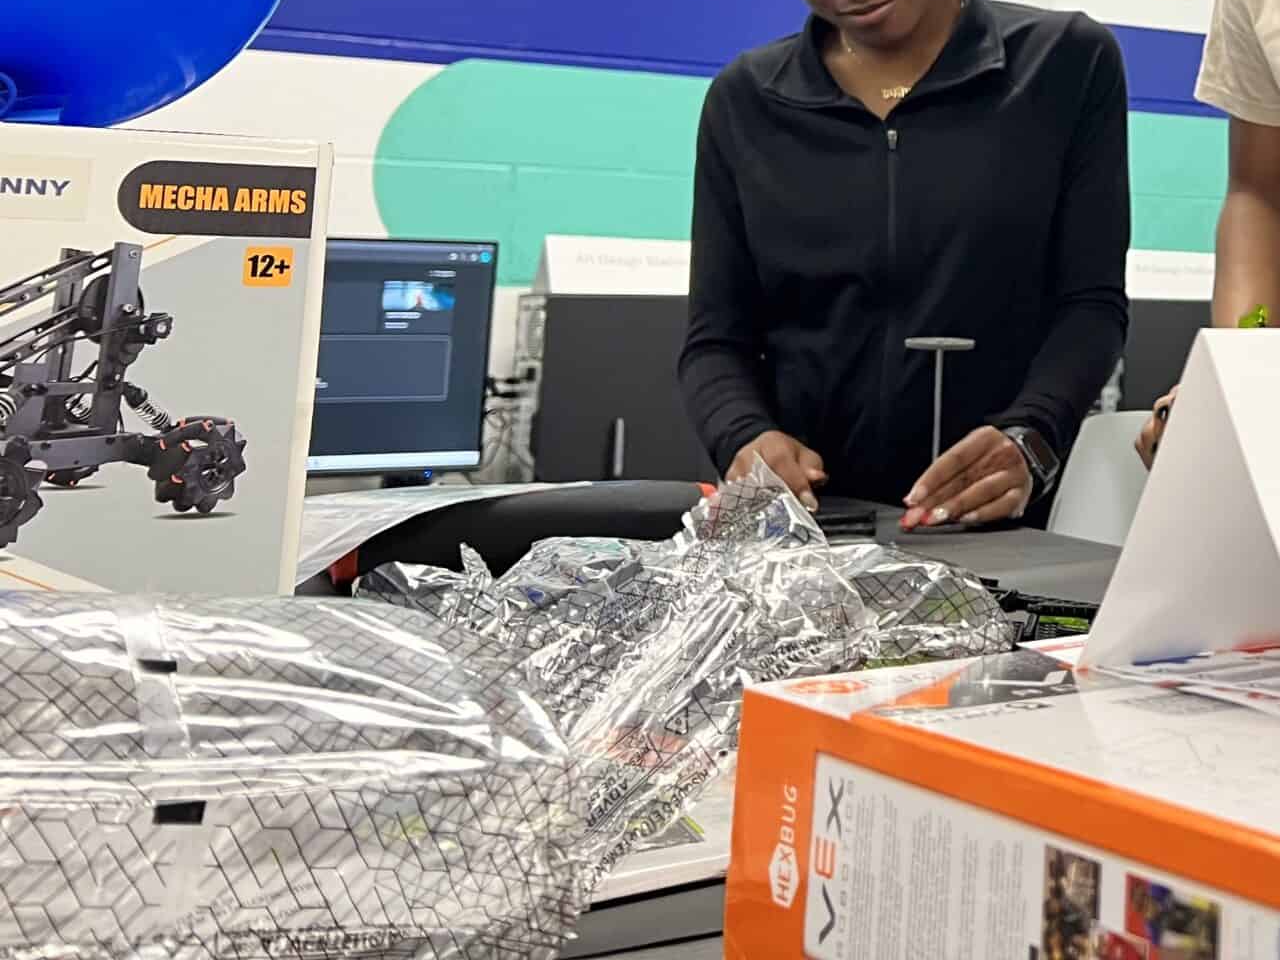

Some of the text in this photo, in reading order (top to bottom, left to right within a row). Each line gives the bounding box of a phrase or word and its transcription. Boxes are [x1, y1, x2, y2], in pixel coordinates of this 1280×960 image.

[139, 183, 307, 215] MECHA ARMS
[247, 254, 290, 279] 12+
[775, 783, 799, 906] HEXBUG
[815, 777, 845, 945] VEX
